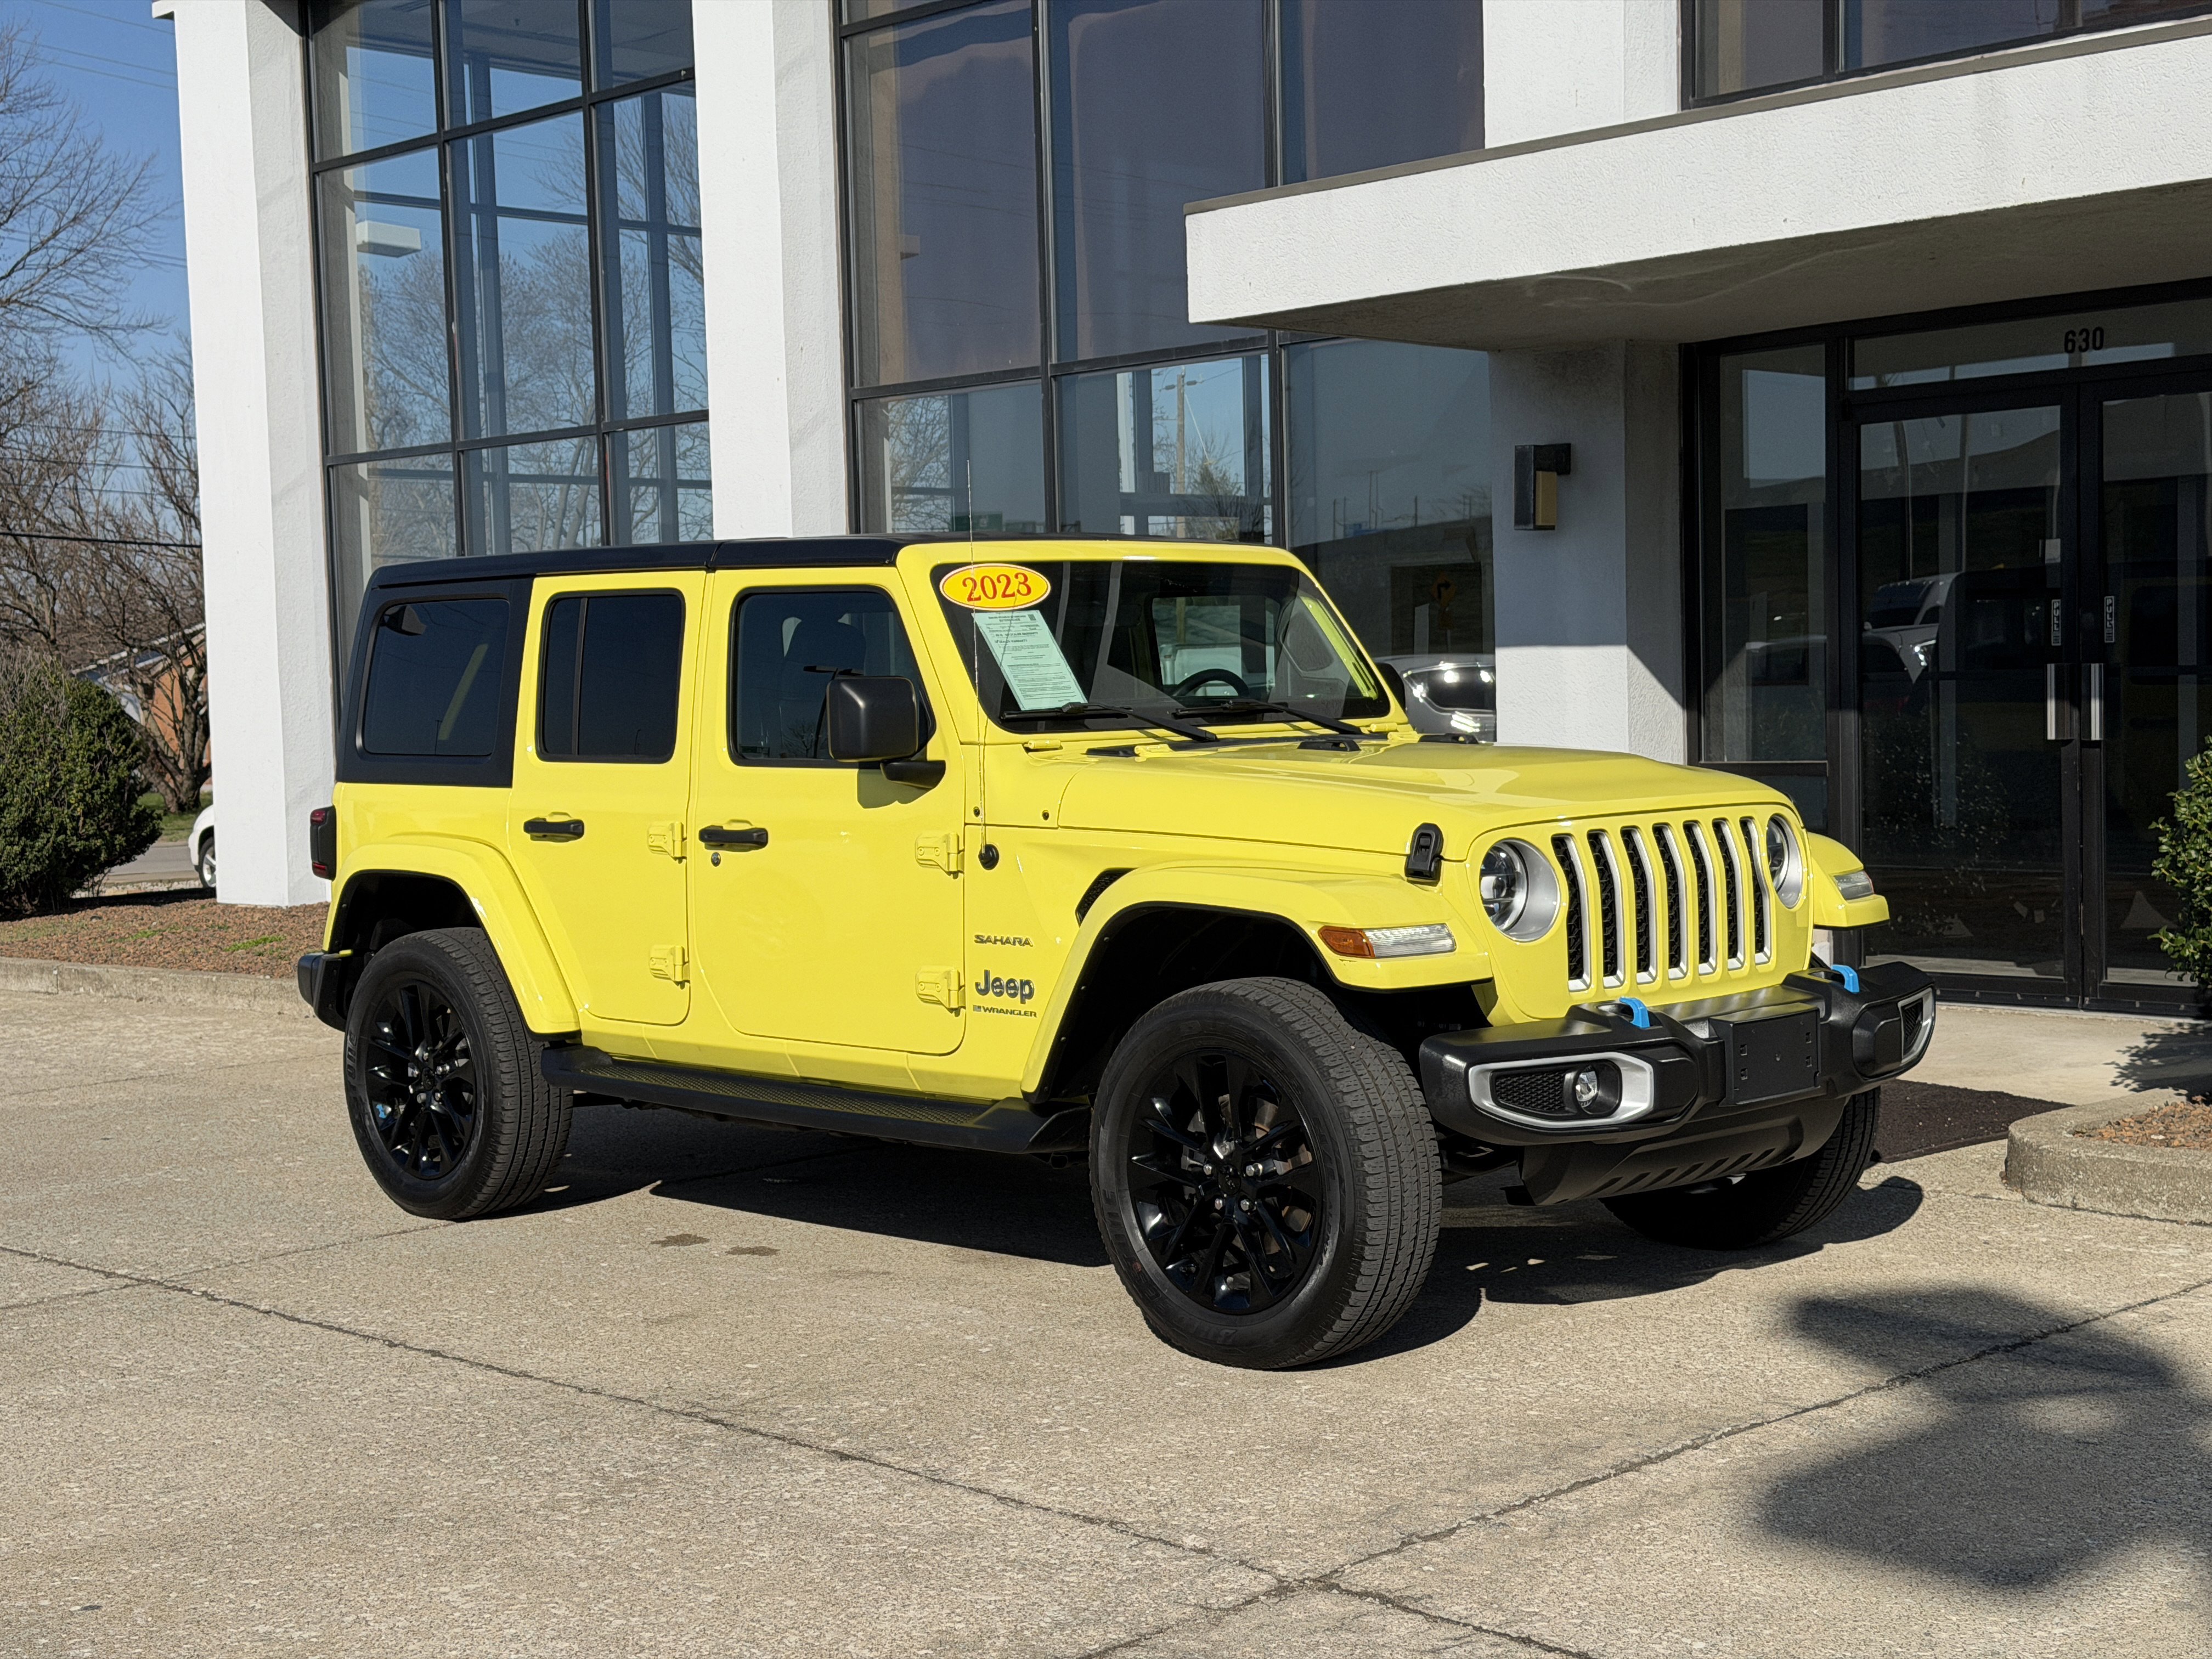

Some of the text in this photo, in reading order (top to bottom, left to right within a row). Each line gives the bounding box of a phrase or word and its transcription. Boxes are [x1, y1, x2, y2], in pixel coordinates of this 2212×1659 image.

[2064, 327, 2104, 353] 630
[962, 572, 1031, 602] 2023
[974, 934, 1034, 947] SAHARA
[975, 969, 1035, 1005] Jeep
[982, 1006, 1037, 1018] WRANGLER
